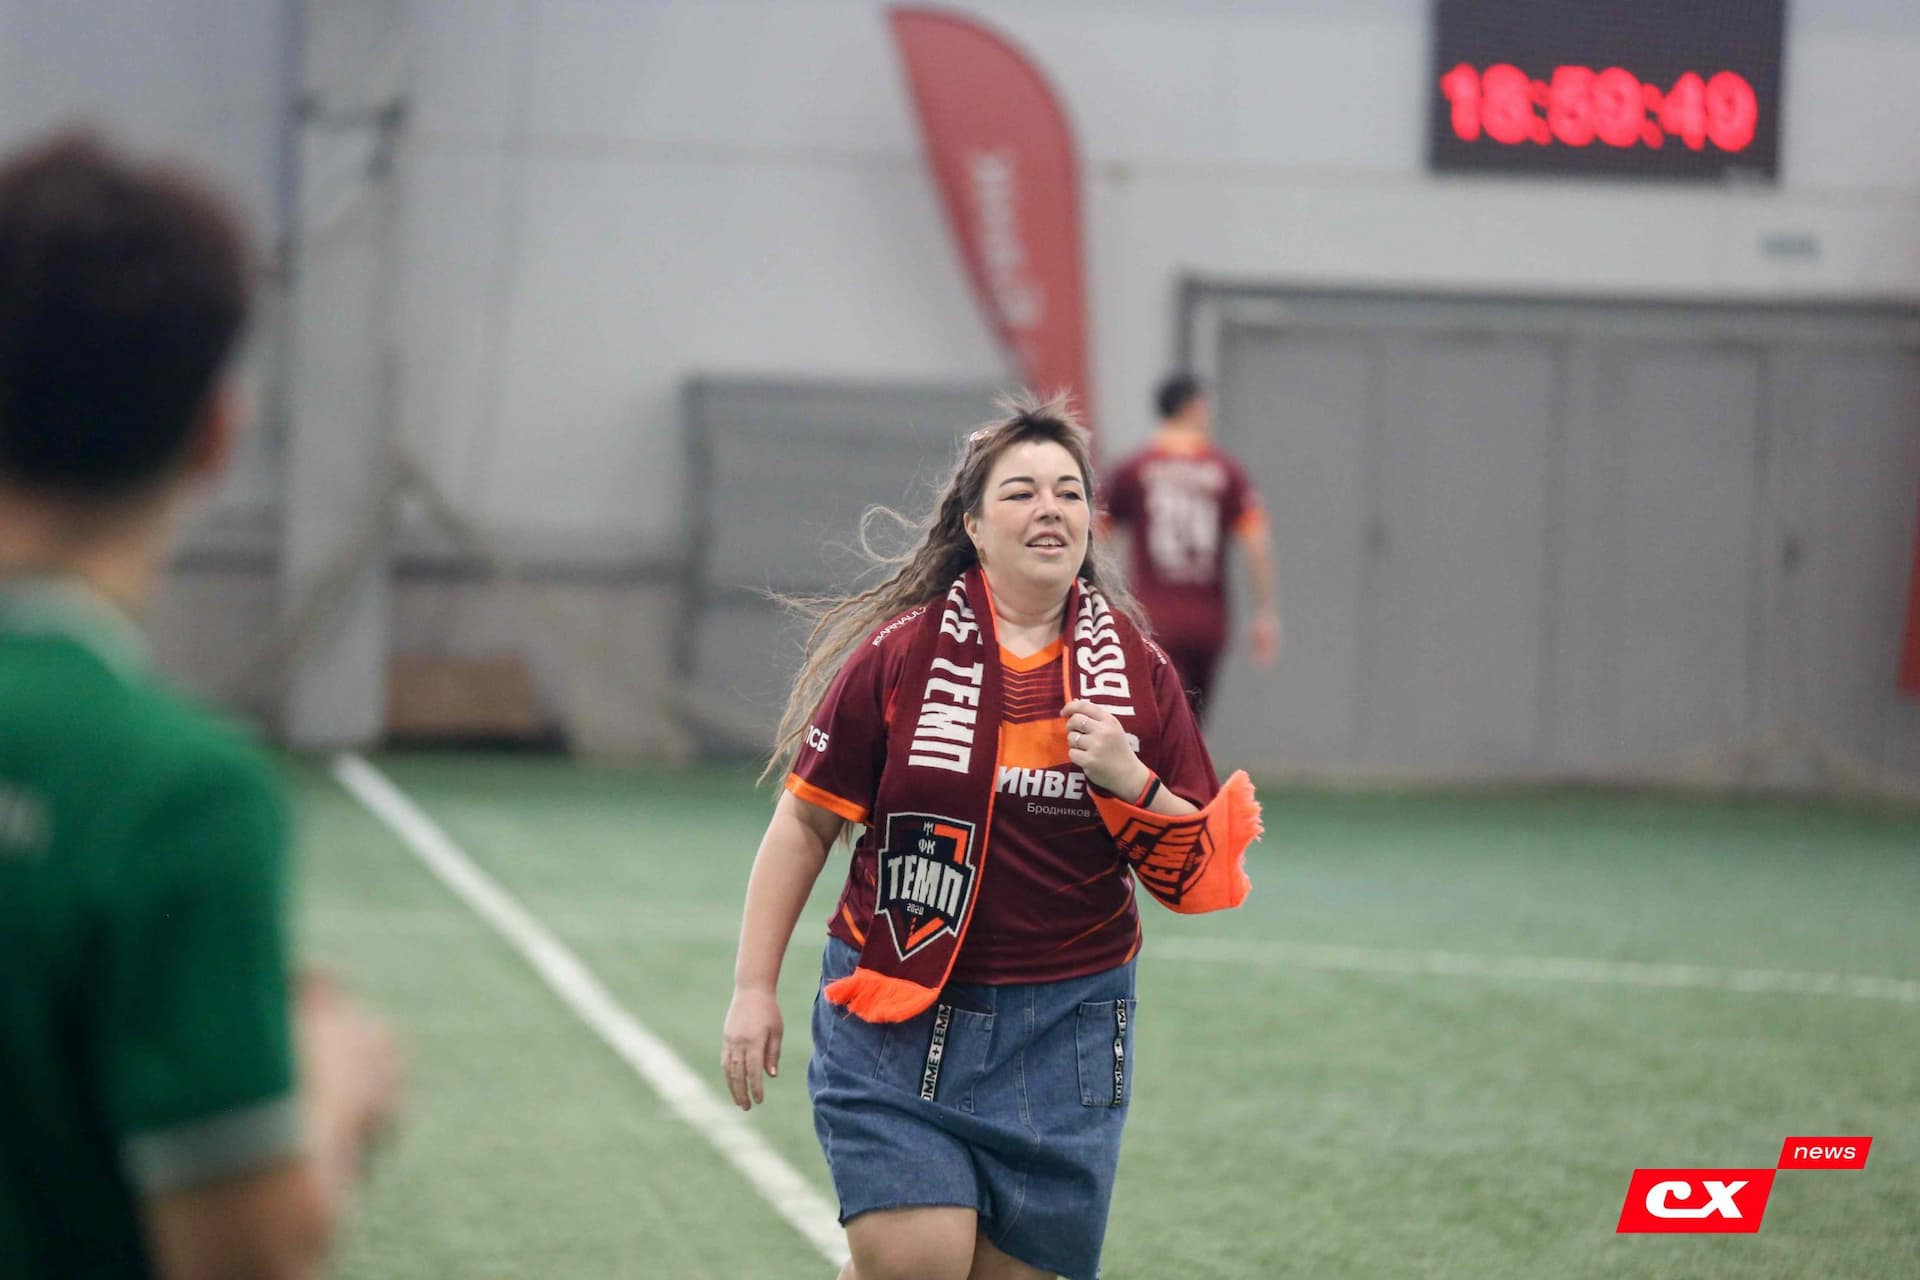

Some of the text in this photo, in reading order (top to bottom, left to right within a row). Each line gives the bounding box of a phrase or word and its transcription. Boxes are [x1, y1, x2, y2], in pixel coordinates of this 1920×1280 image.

[908, 657, 985, 774] ТЕМП
[1027, 802, 1091, 818] Бродников
[918, 838, 936, 855] ФК
[888, 855, 964, 917] ТЕМП
[906, 902, 925, 916] 2020
